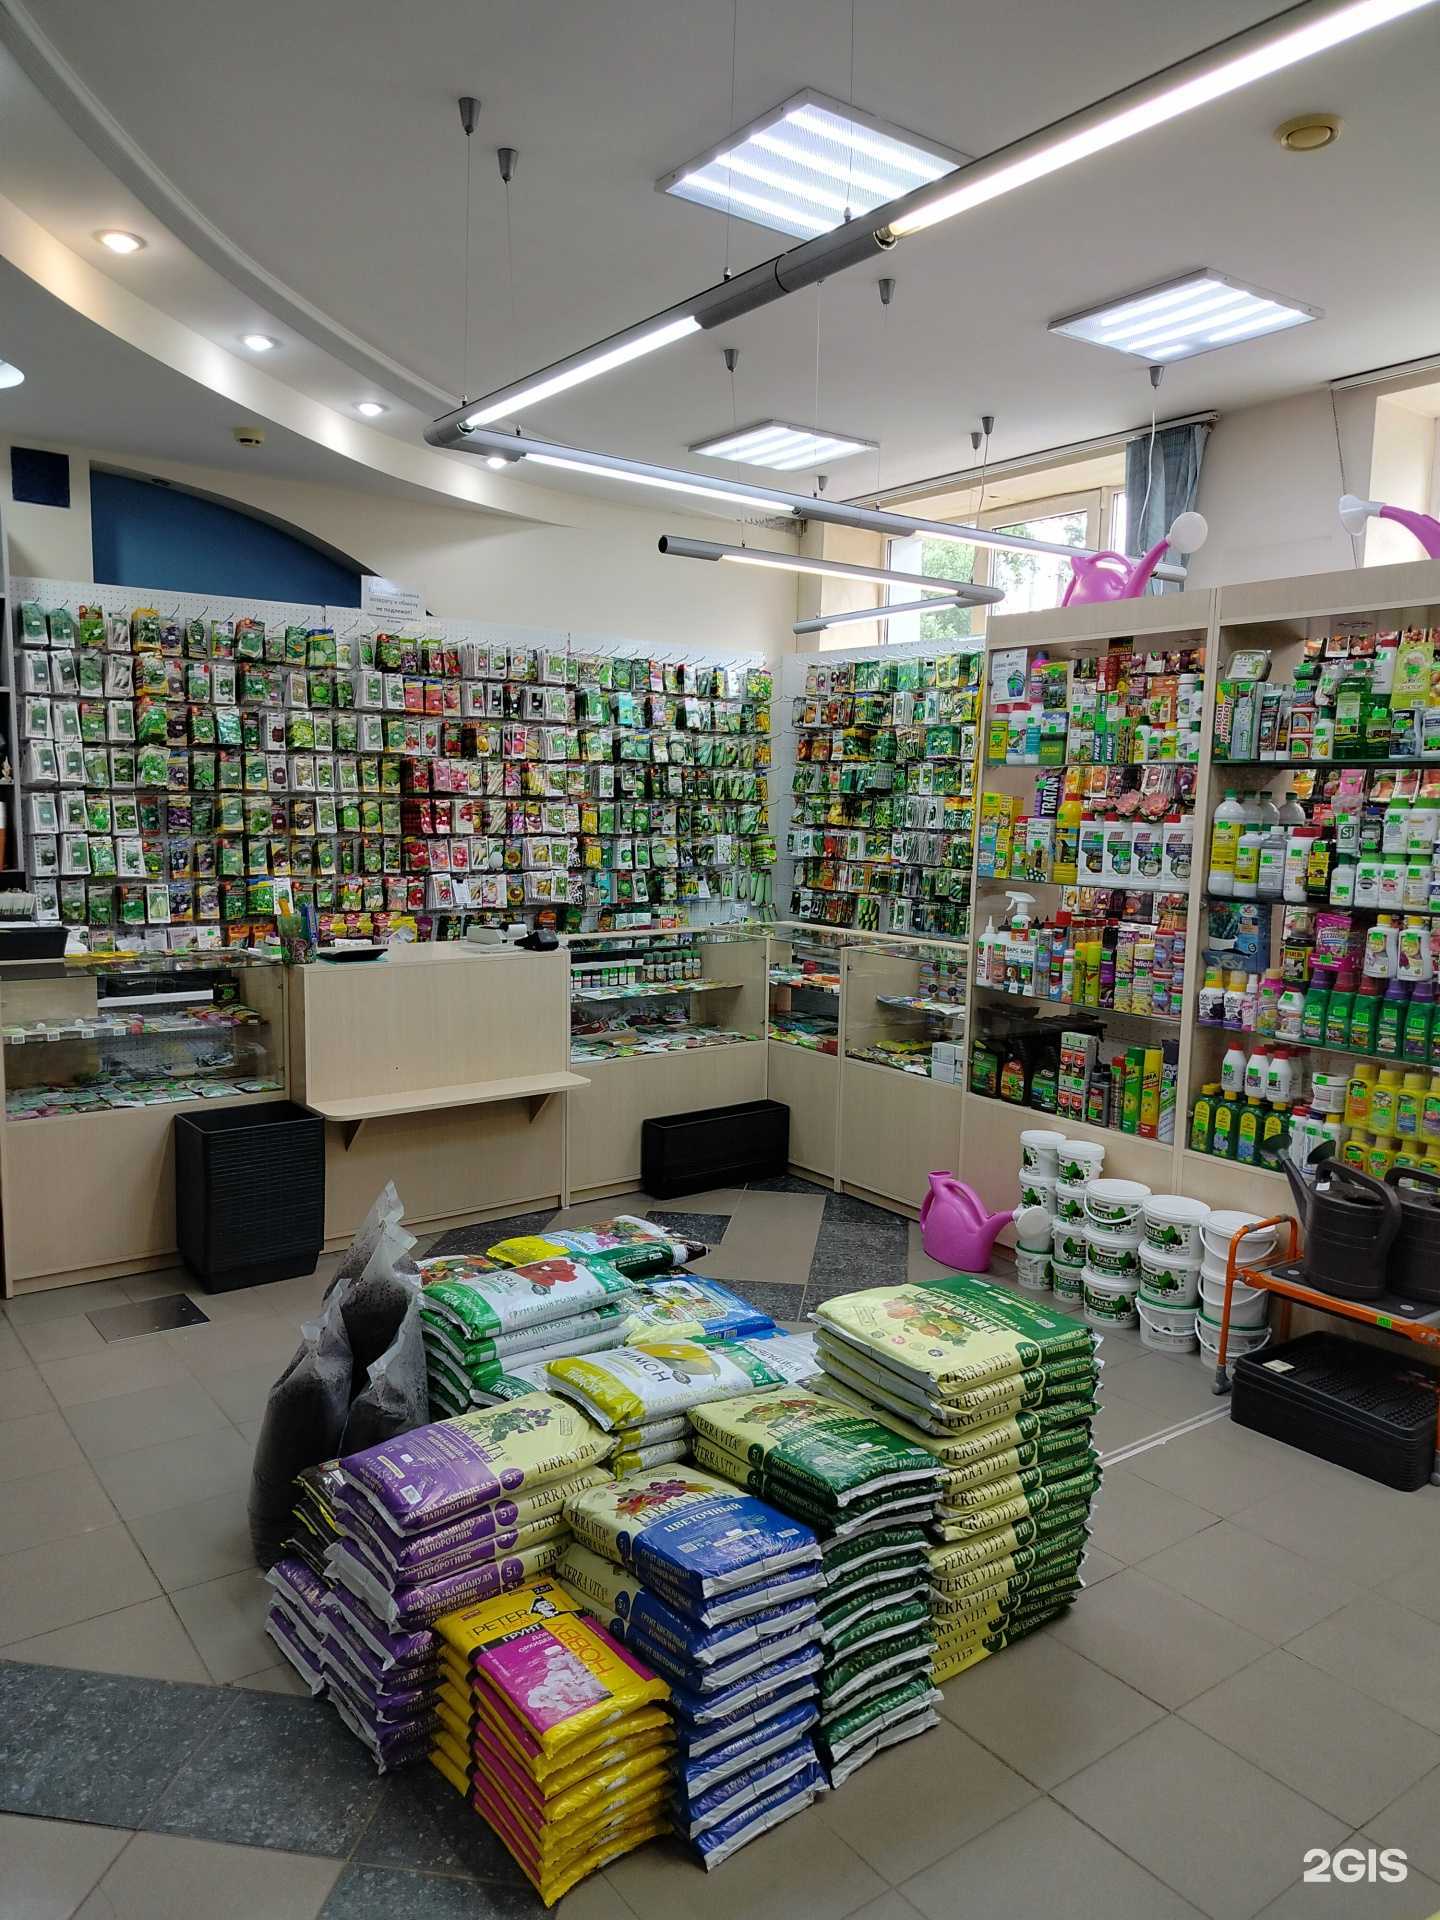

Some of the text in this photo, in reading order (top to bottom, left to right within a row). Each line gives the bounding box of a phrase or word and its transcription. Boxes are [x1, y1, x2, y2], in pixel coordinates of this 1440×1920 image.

[1041, 776, 1061, 816] TRATAN
[1342, 827, 1354, 838] Si
[1096, 1253, 1120, 1265] КРАСКА
[1045, 1341, 1074, 1355] UNIVERSAL
[614, 1349, 672, 1383] ЛИМОН
[695, 1414, 719, 1439] TERRA
[719, 1429, 738, 1450] VITA
[943, 1438, 986, 1461] TERRA
[985, 1426, 1012, 1446] VITA
[535, 1452, 573, 1474] TERRA
[572, 1443, 598, 1461] VITA
[695, 1446, 719, 1468] TERRA
[984, 1452, 1009, 1471] VITA
[1042, 1440, 1072, 1454] UNIVERSAL
[527, 1484, 567, 1510] TERRA
[568, 1475, 593, 1495] VITA
[987, 1476, 1013, 1497] VITA
[422, 1494, 478, 1521] ПАПОРОТНИК
[568, 1508, 591, 1534] TERRA
[663, 1501, 744, 1533] ЦВЕТОЧНЫЙ
[995, 1501, 1019, 1520] VITA
[417, 1529, 473, 1557] ПАПОРОТНИК
[942, 1543, 981, 1571] TERRA
[982, 1533, 1007, 1553] VITA
[1016, 1523, 1032, 1538] 10L
[416, 1551, 473, 1580] ПАПОРОТНИК
[564, 1563, 588, 1590] TERRA
[935, 1569, 979, 1593] TERRA
[980, 1559, 1005, 1582] VITA
[1014, 1552, 1032, 1566] 10L
[425, 1588, 478, 1613] ПАПОРОТНИК
[1025, 1581, 1055, 1598] UNIVERSAL
[472, 1609, 530, 1636] PETER
[502, 1623, 541, 1643] ГРУНТ
[545, 1621, 615, 1676] HOBBY
